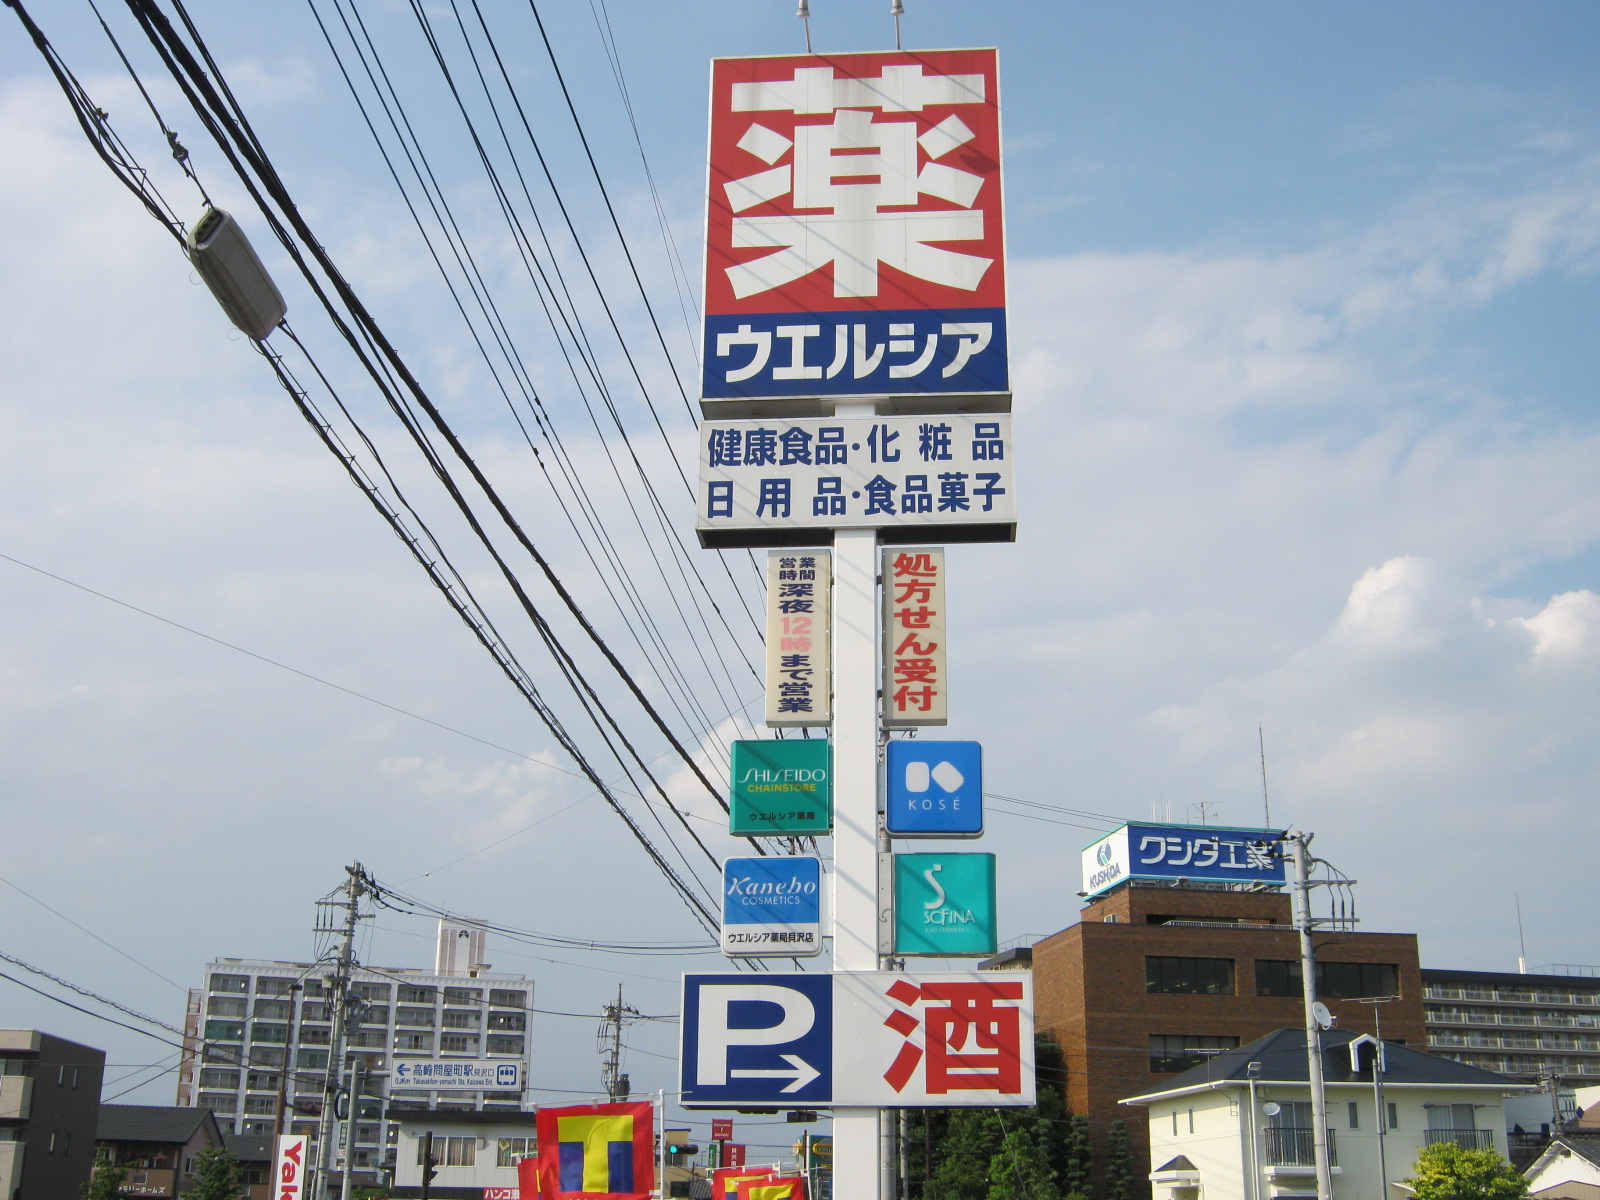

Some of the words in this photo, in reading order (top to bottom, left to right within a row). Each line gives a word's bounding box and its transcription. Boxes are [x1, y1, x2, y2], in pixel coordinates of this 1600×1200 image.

[723, 64, 994, 300] 薬
[716, 322, 993, 383] ウエルシア
[892, 553, 938, 712] 処方せん受付
[737, 768, 826, 783] SHISEIDO
[747, 783, 816, 793] CHAINSTORE
[908, 797, 960, 811] KOSÉ
[1139, 836, 1274, 870] クシダ工業
[728, 876, 816, 896] Kanebo
[1090, 861, 1121, 889] KUSHIDA
[742, 895, 800, 906] COSMETICS
[924, 908, 976, 926] SOFINA
[728, 932, 814, 944] ウエルシア薬局貝沢店
[697, 984, 815, 1085] P
[883, 979, 1023, 1094] 酒
